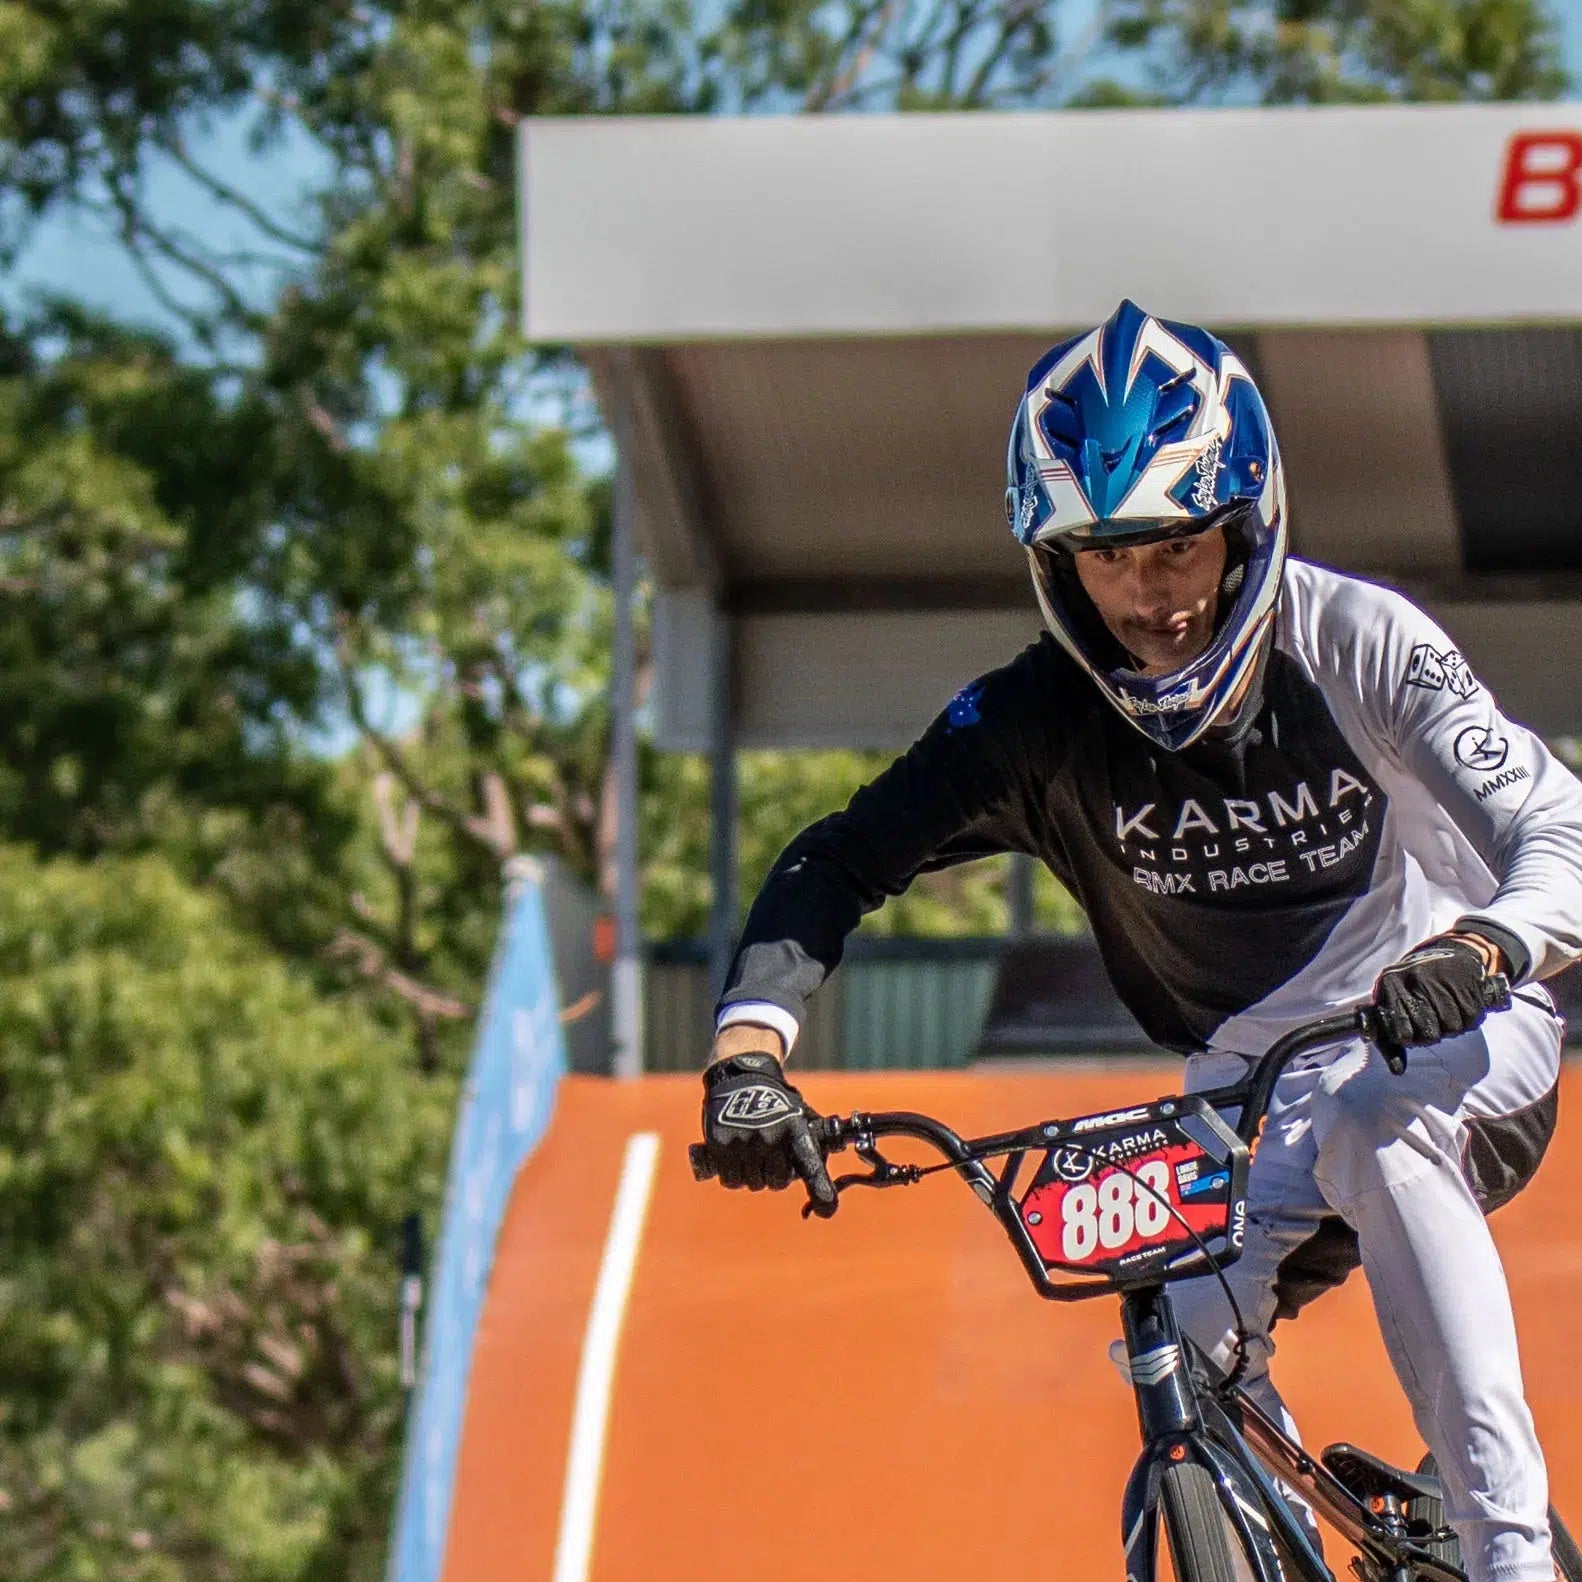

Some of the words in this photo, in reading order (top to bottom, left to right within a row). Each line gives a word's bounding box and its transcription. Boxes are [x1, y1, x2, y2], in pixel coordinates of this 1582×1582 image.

[1115, 768, 1369, 840] KARMA
[1133, 866, 1197, 895] BMX
[1207, 859, 1290, 892] RACE
[1299, 818, 1370, 873] TEAM
[1092, 1127, 1167, 1158] KARMA
[1061, 1159, 1171, 1262] 888
